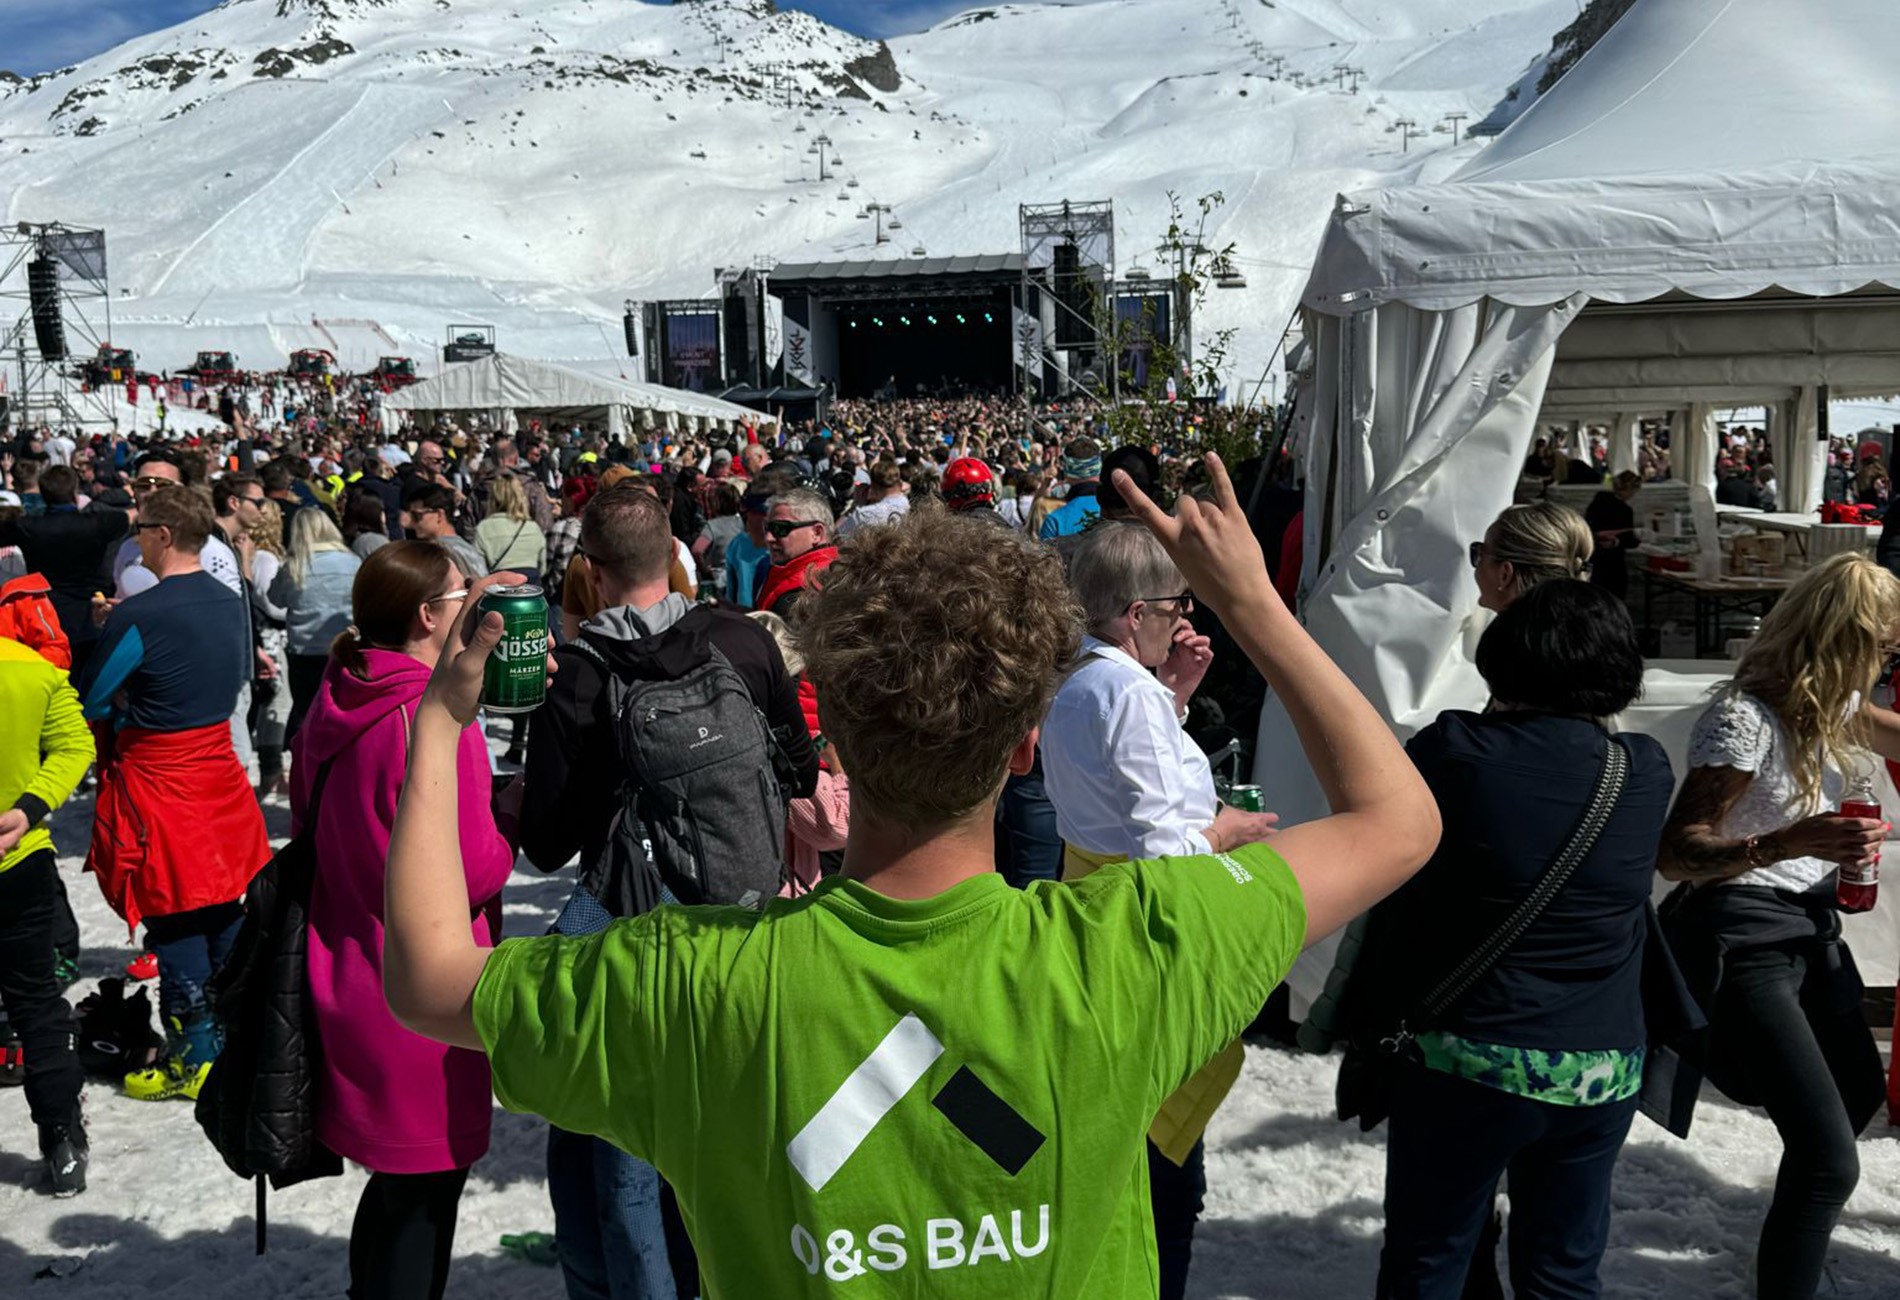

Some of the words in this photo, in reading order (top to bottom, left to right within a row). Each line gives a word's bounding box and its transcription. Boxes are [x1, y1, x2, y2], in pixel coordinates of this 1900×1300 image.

[494, 629, 548, 662] Gösse
[790, 1222, 908, 1282] O&S
[926, 1204, 1050, 1270] BAU
